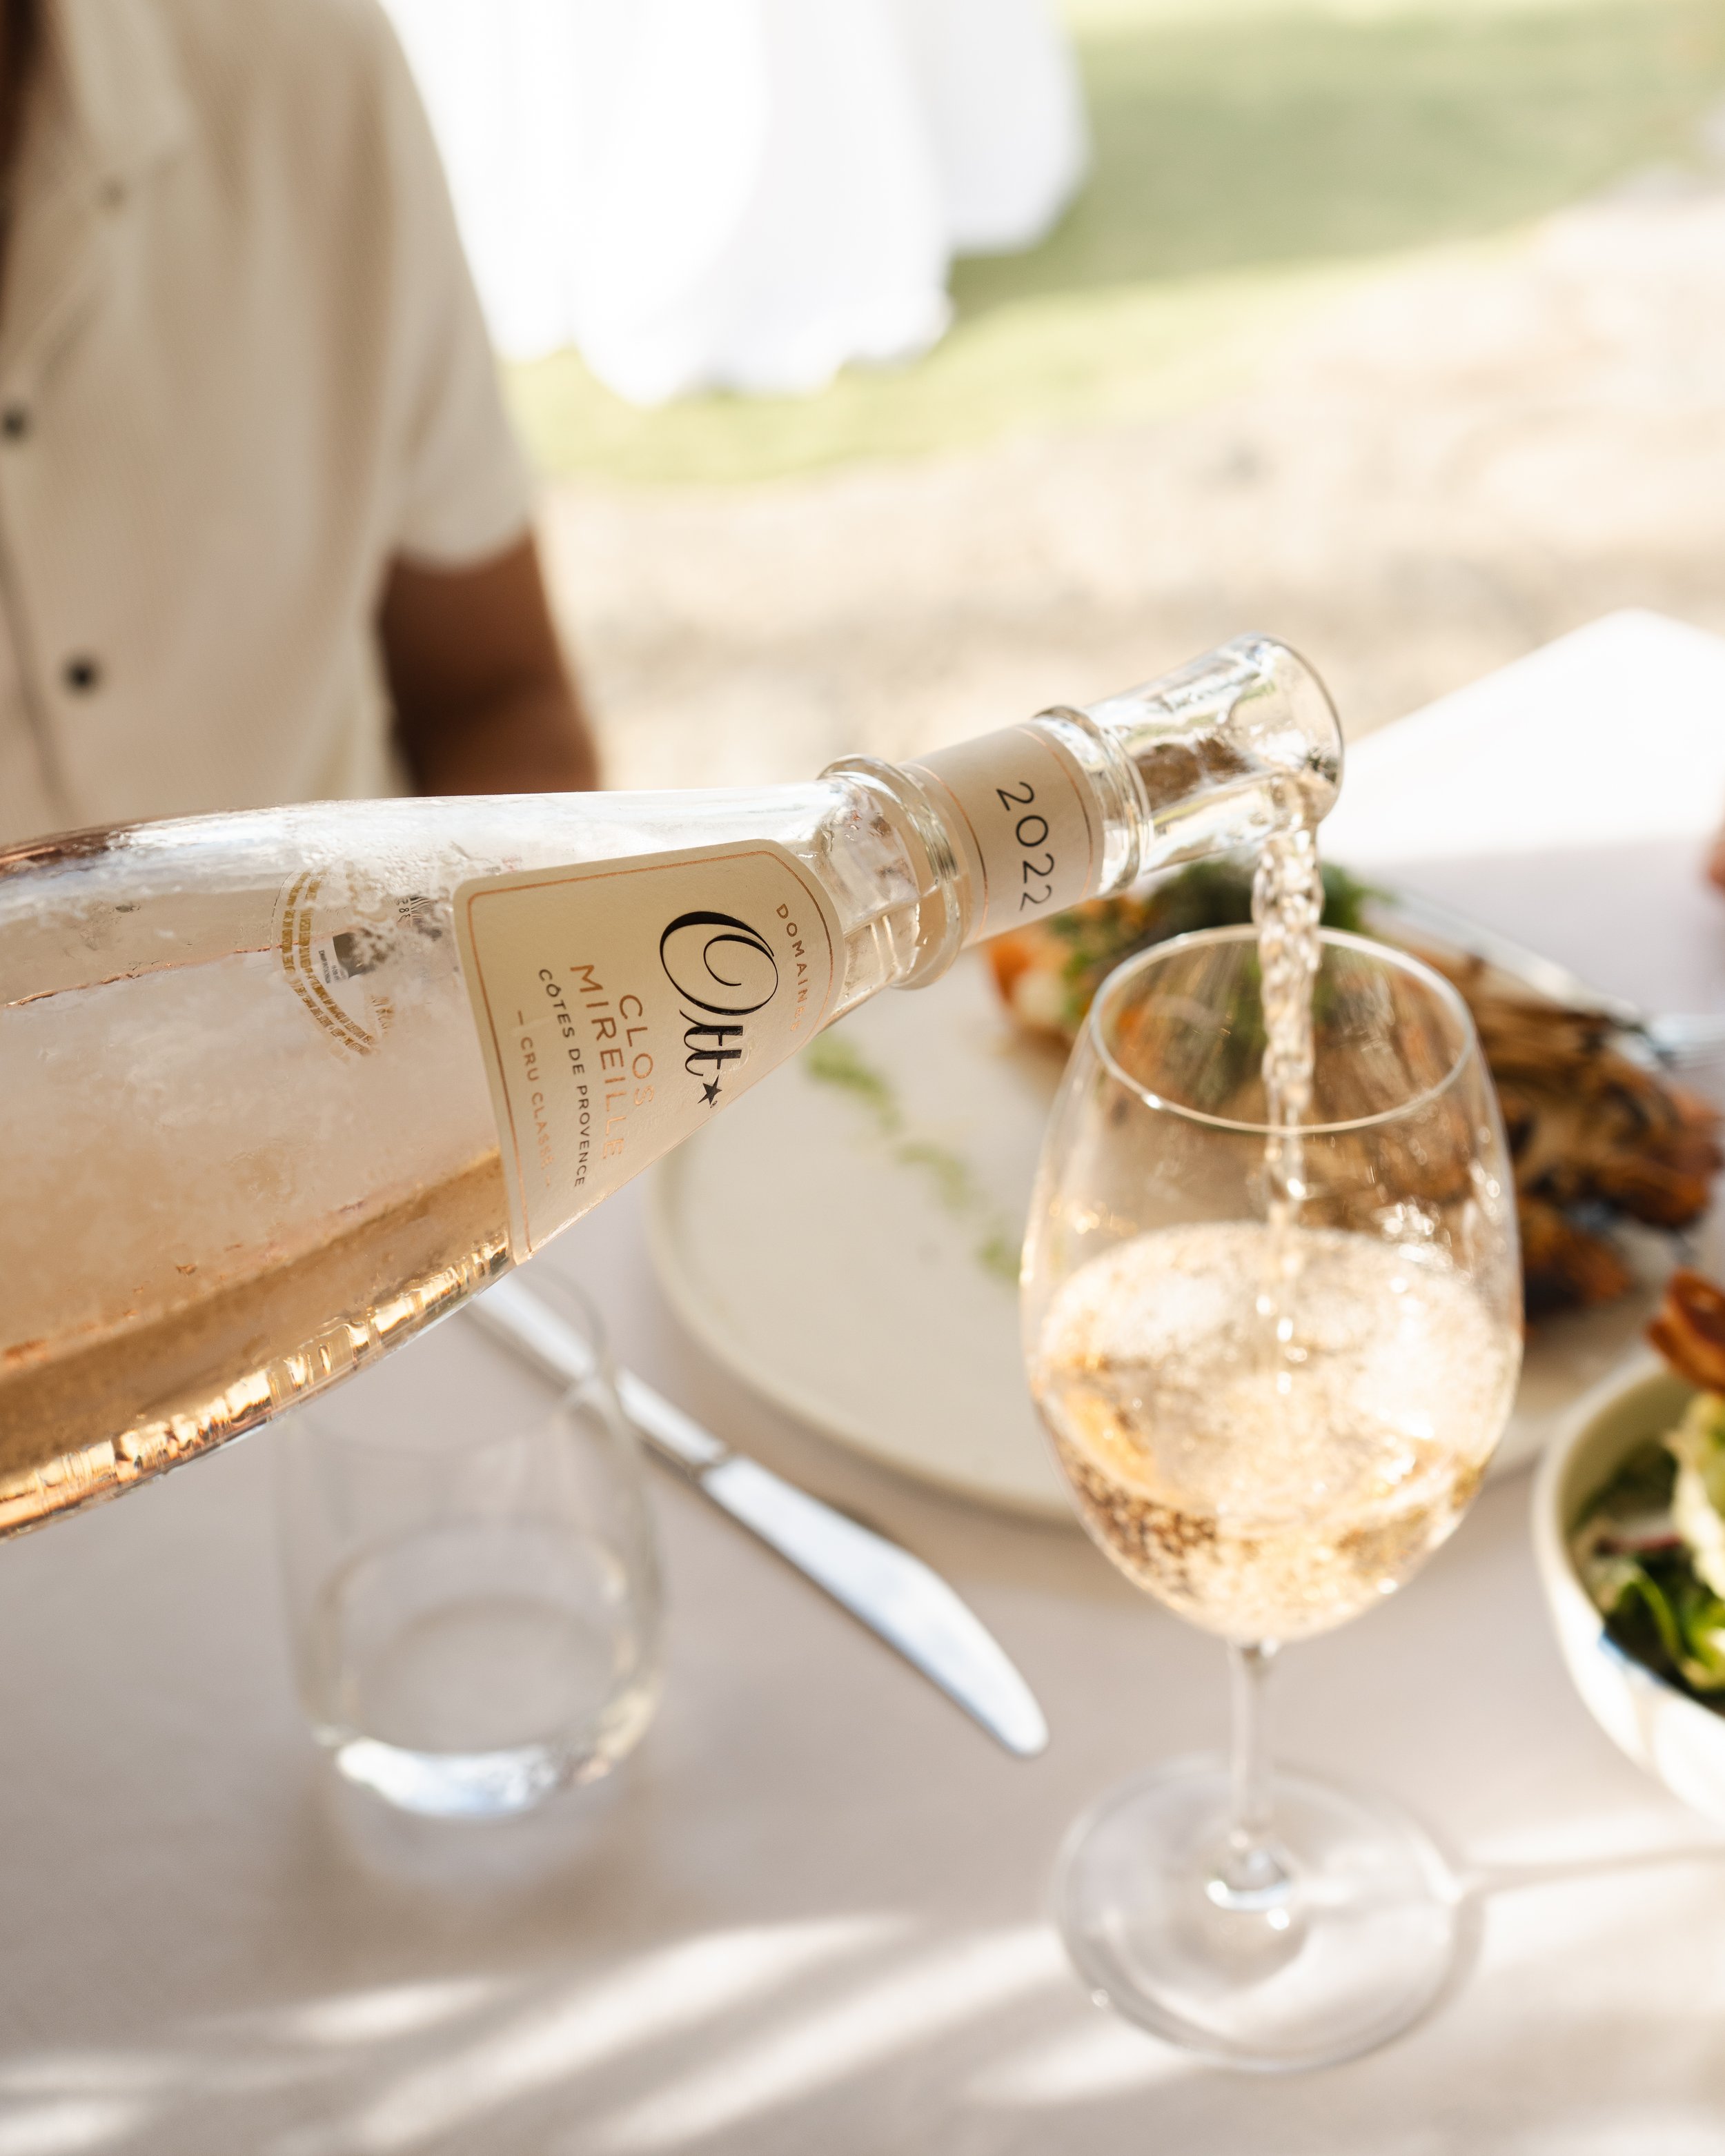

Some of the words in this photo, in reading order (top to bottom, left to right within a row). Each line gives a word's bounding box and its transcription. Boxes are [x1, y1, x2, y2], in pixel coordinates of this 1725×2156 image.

[995, 781, 1055, 912] 2022
[538, 969, 575, 1038] CÔTES
[660, 911, 779, 1077] Ott
[776, 903, 809, 1033] DOMAINES
[520, 1037, 539, 1081] CRU
[568, 1048, 585, 1074] DE
[570, 965, 627, 1160] MIREILLE
[620, 993, 655, 1107] CLOS
[573, 1085, 591, 1188] PROVENCE
